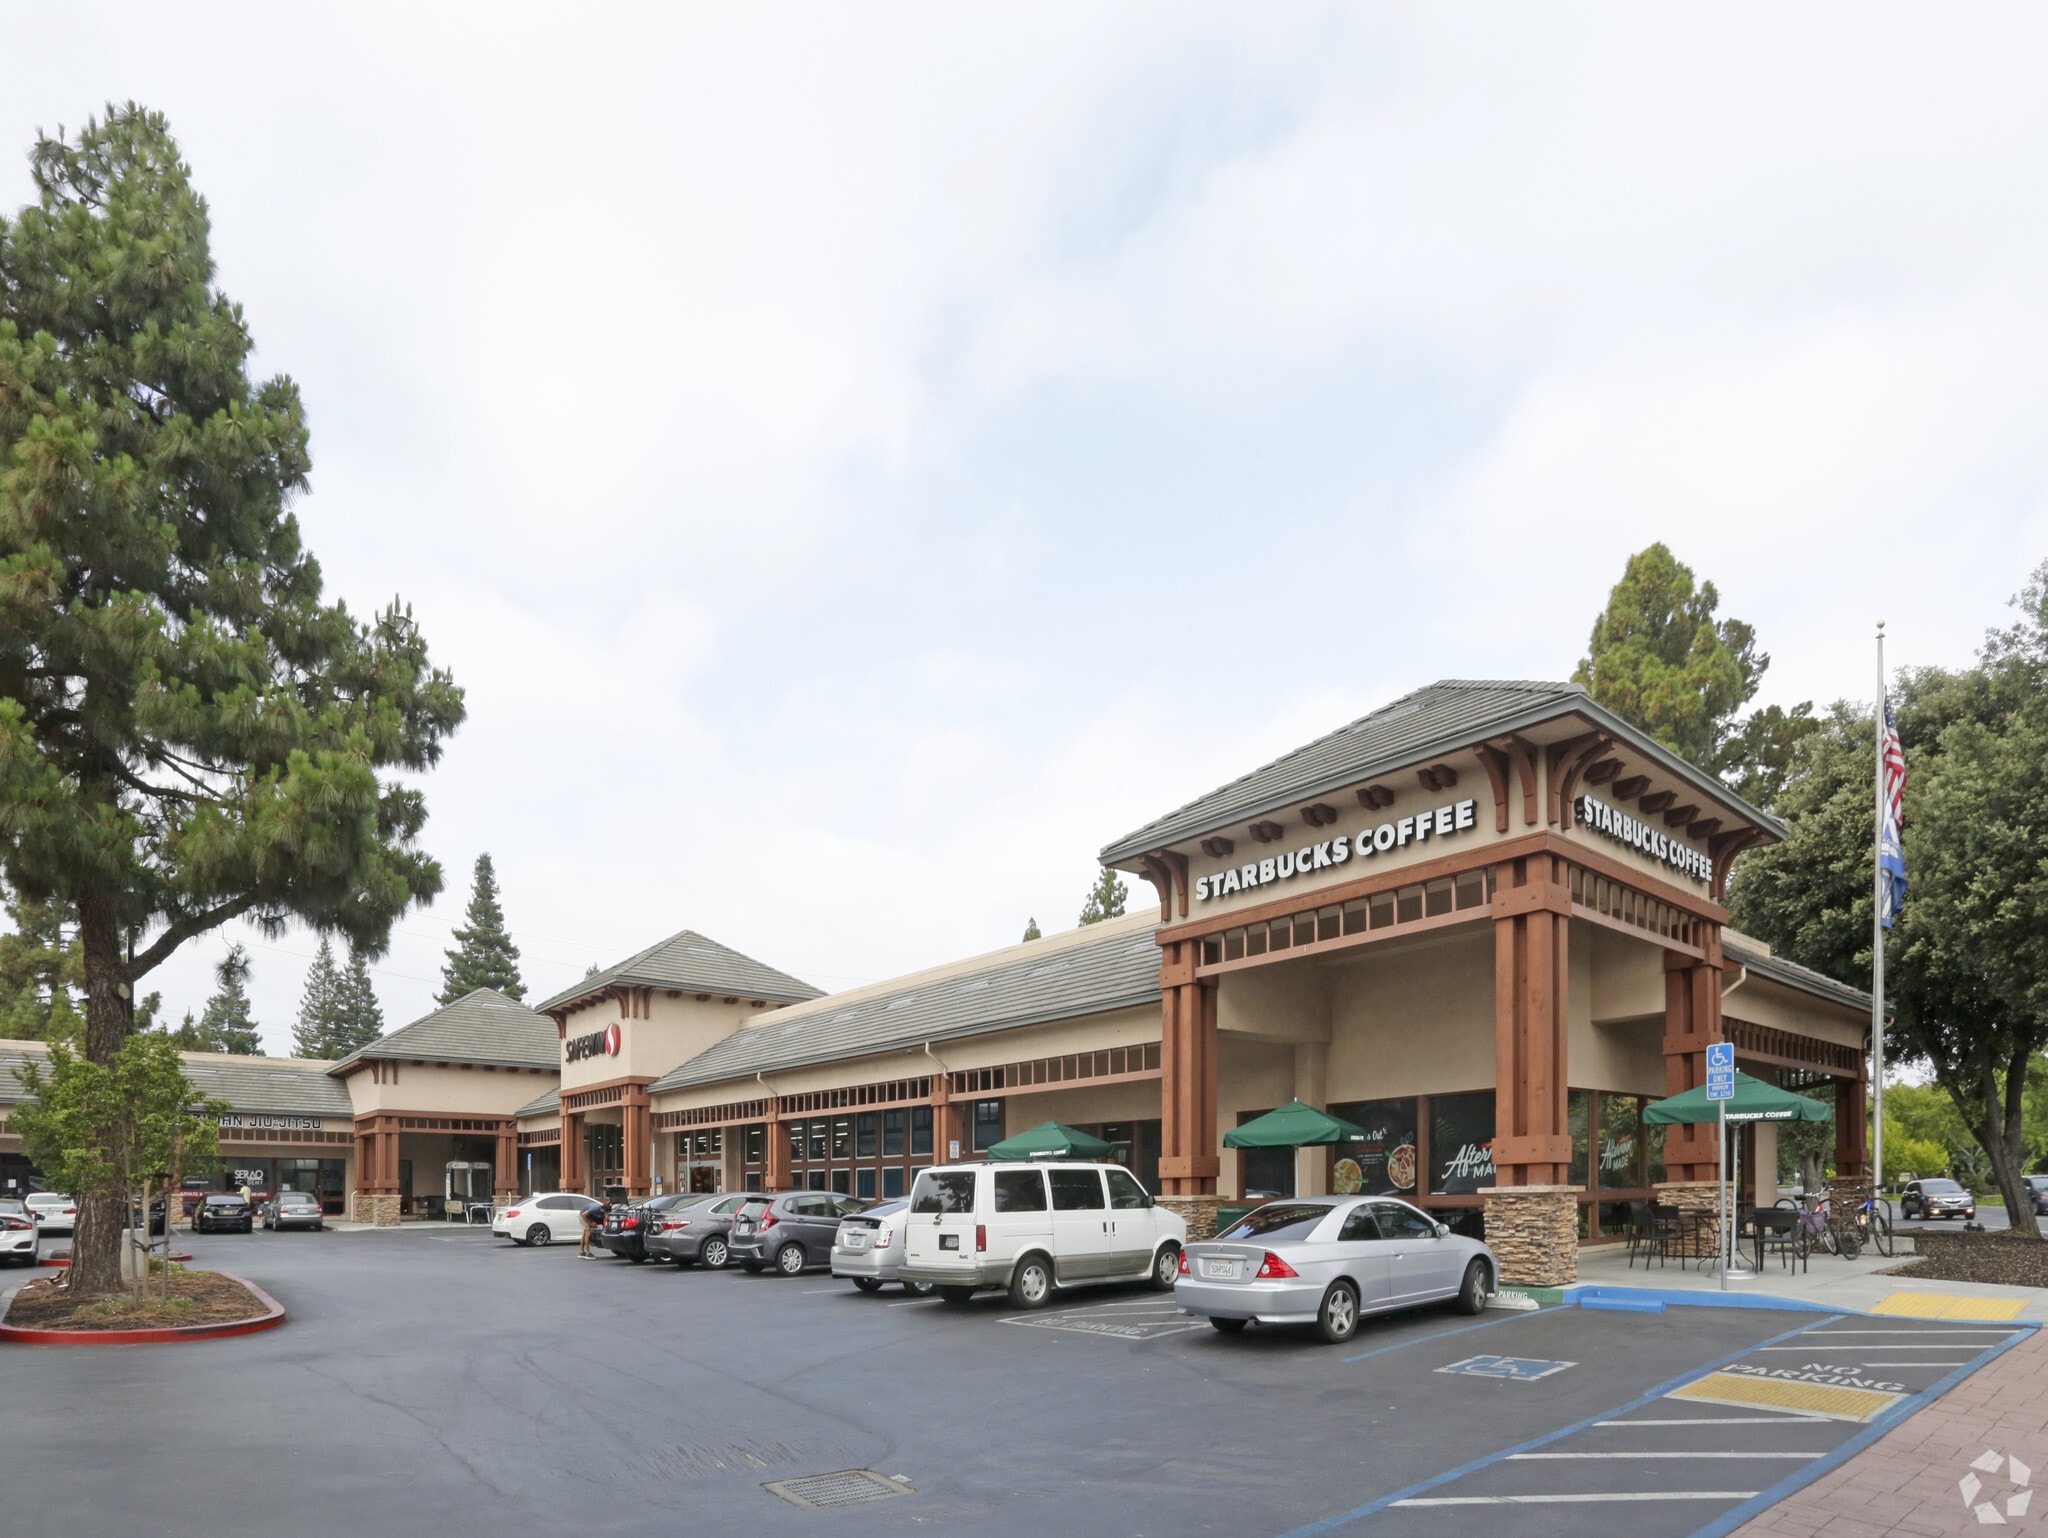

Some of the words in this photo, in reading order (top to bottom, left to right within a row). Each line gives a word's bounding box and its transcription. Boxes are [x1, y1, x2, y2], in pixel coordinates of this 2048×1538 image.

[1583, 794, 1667, 860] STARBUCKS
[1669, 840, 1713, 882] COFFEE
[1195, 836, 1348, 900] STARBUCKS
[1355, 799, 1473, 856] COFFEE
[566, 1030, 606, 1063] SAFEWA
[1708, 1065, 1732, 1074] PARKING
[1713, 1074, 1727, 1083] ONLY
[249, 1115, 322, 1130] JIU-JITSU
[1724, 1112, 1763, 1120] TARBUCKS
[1764, 1110, 1792, 1118] COFFEE
[1441, 1143, 1493, 1180] After
[1498, 1290, 1528, 1300] PARKING
[1801, 1363, 1863, 1376] NO
[1721, 1364, 1906, 1391] PARKING
